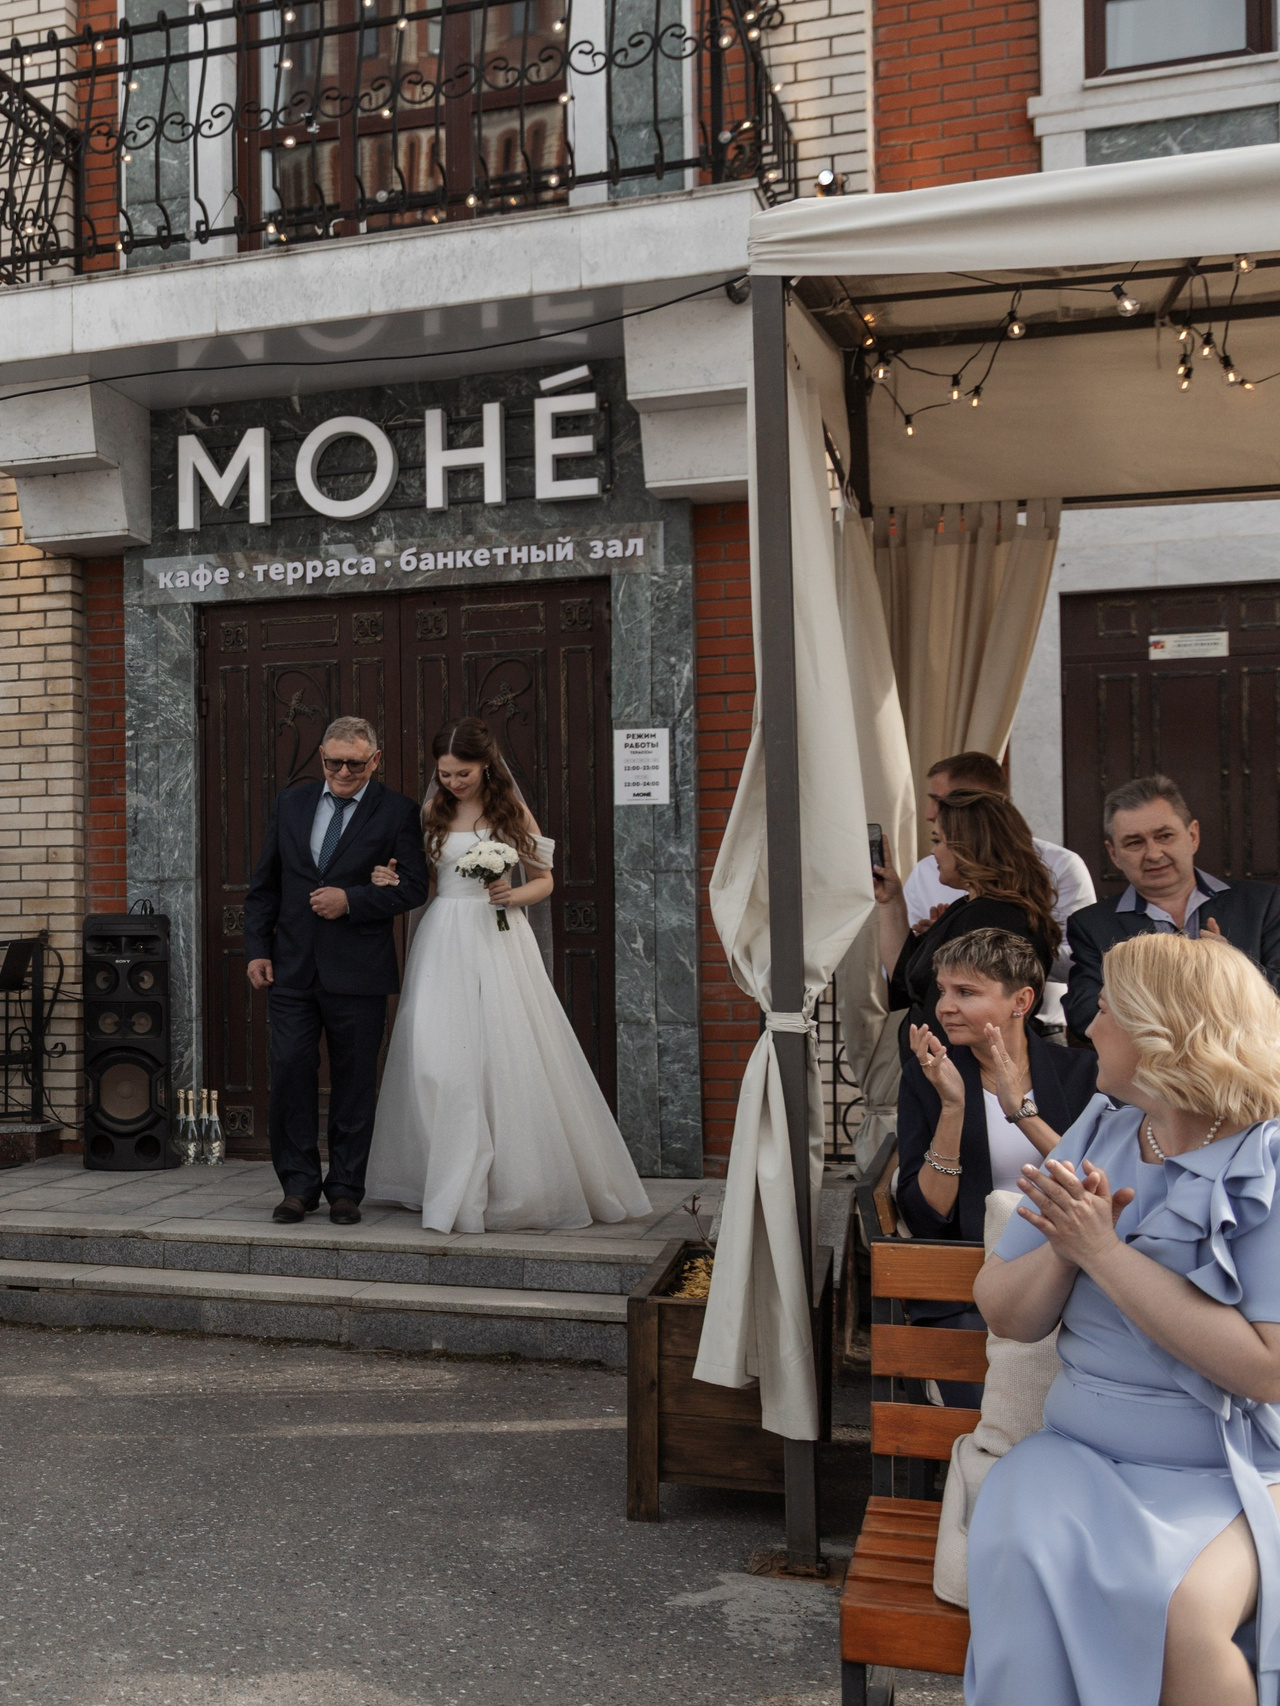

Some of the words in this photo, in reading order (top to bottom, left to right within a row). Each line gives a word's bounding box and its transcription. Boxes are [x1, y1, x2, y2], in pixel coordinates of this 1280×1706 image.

[158, 563, 230, 592] кафе
[252, 556, 377, 586] терраса
[399, 536, 574, 572] банкетный
[588, 537, 644, 560] зал
[626, 732, 657, 740] РЕЖИМ
[624, 741, 659, 749] РАБОТЫ
